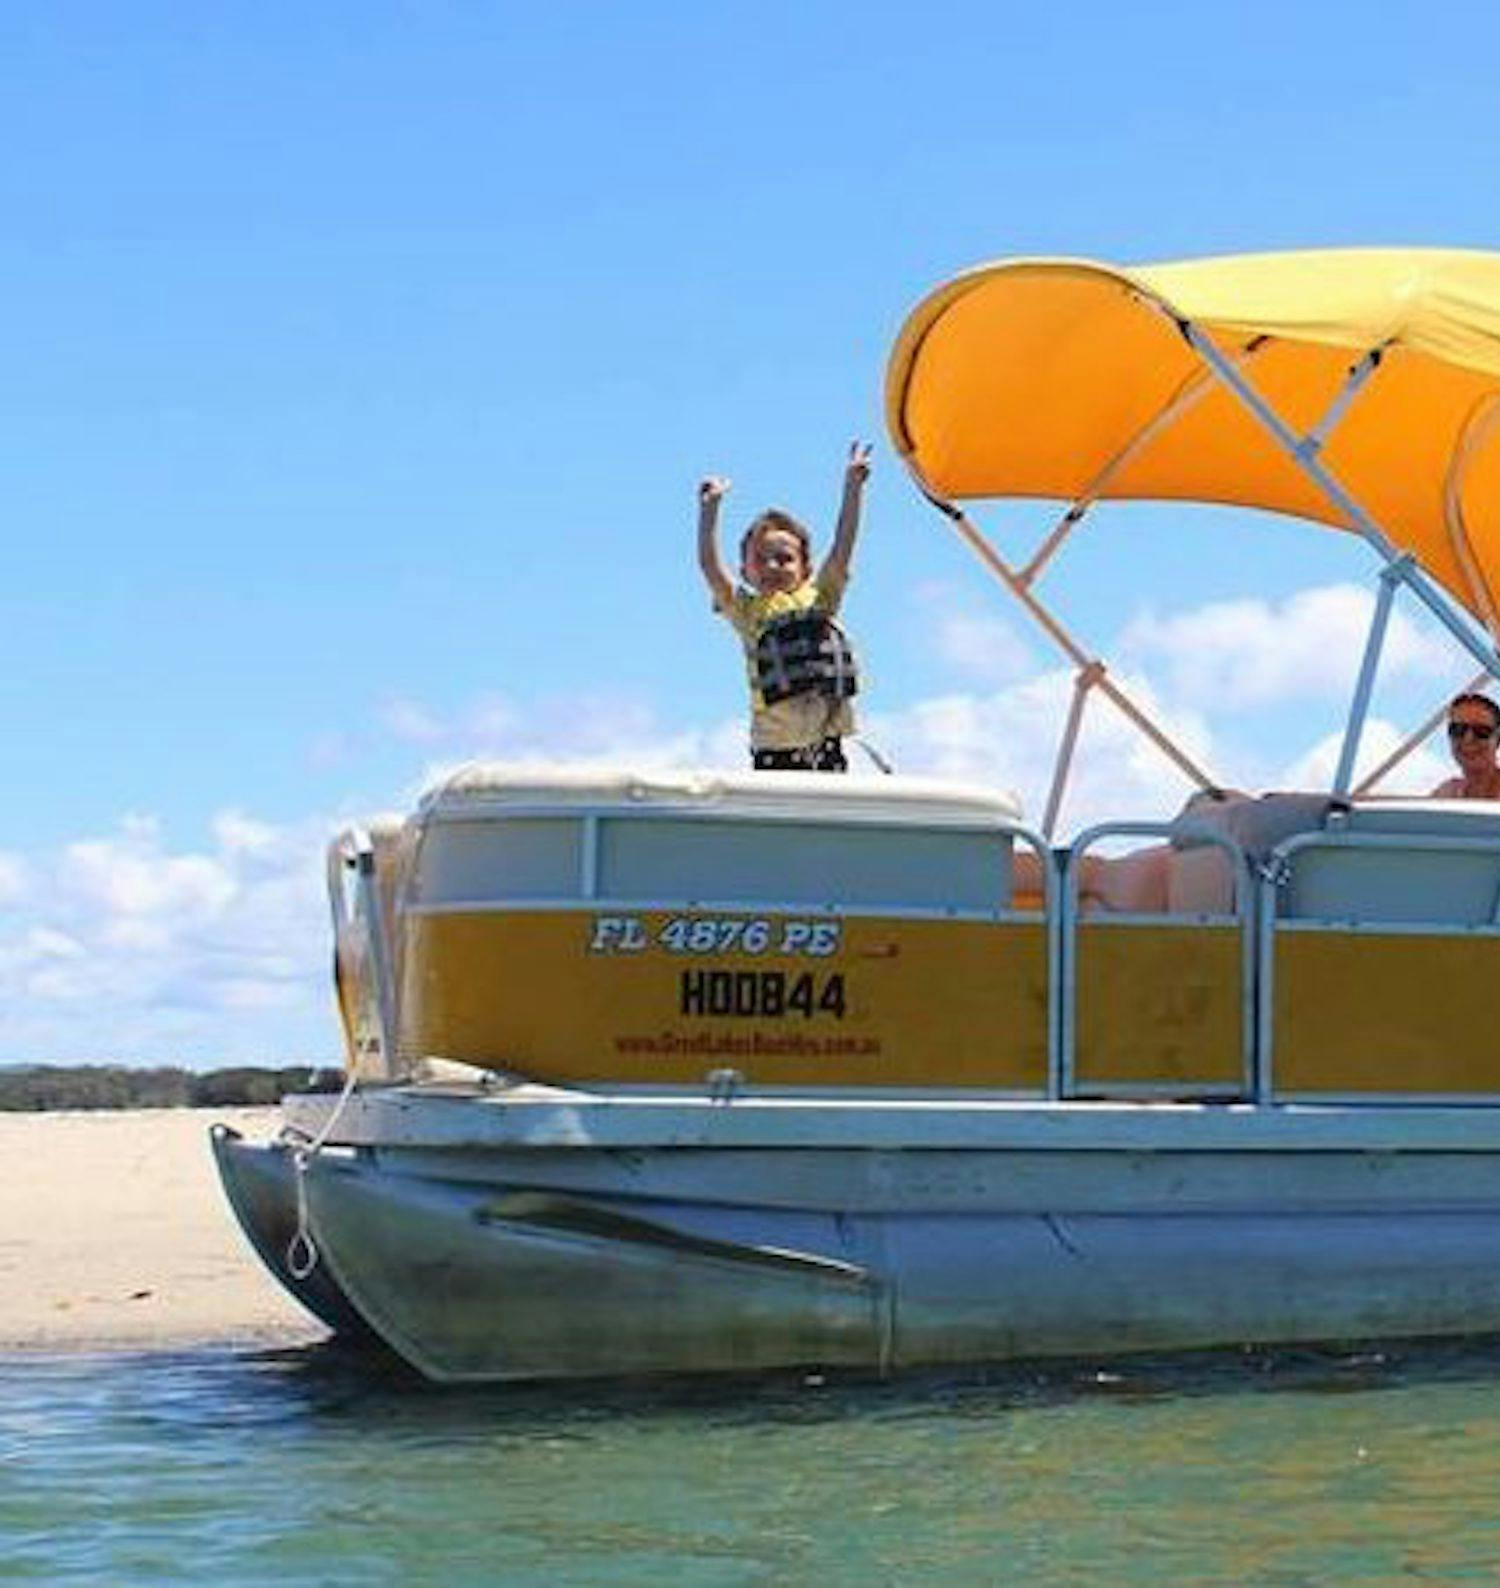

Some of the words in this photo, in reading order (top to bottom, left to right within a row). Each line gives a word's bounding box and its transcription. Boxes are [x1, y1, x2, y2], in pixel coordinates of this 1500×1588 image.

[588, 914, 648, 954] FL
[657, 915, 772, 956] 4876
[777, 917, 841, 958] PE
